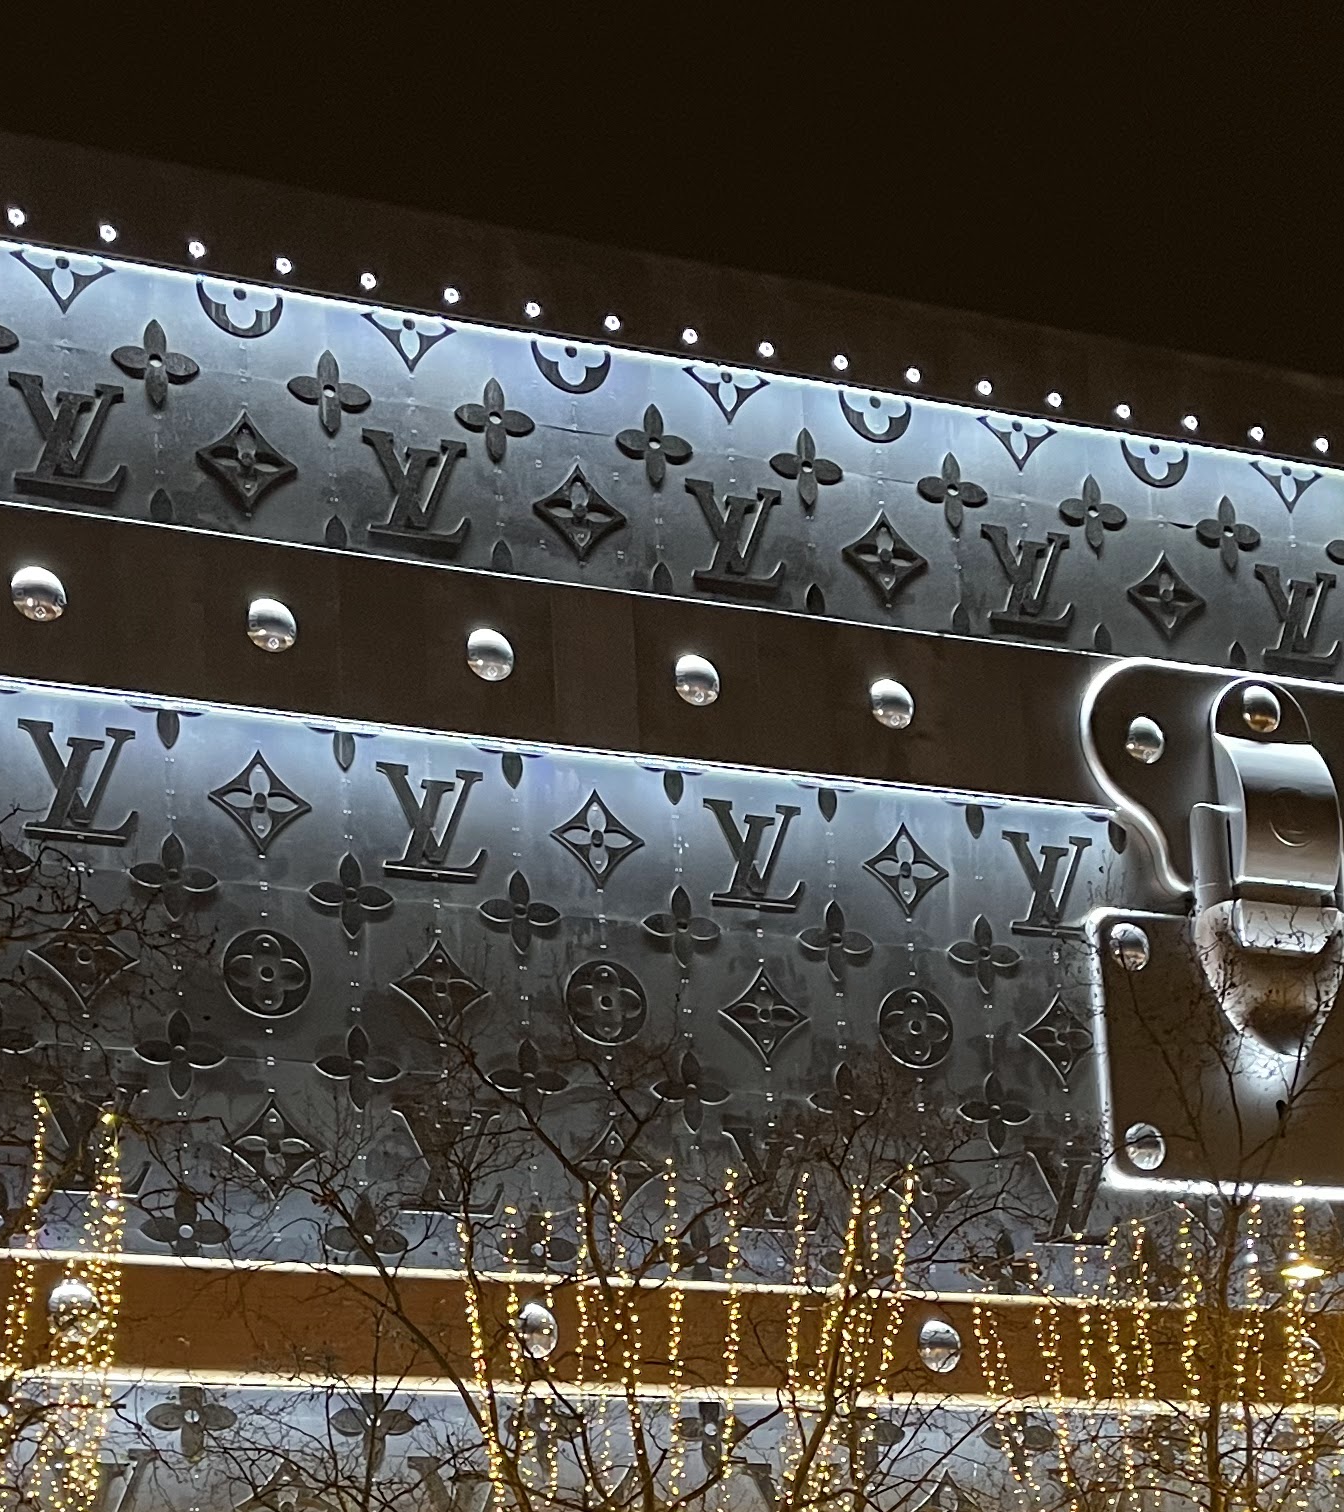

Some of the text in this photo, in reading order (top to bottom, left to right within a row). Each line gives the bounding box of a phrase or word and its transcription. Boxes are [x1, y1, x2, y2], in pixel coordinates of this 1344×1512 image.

[8, 371, 127, 502] LV
[362, 429, 471, 556] LV
[685, 478, 787, 592] LV
[981, 523, 1075, 635] LV
[1254, 564, 1341, 665] LV
[17, 718, 139, 845] LV
[376, 761, 488, 882] LV
[703, 798, 805, 910] LV
